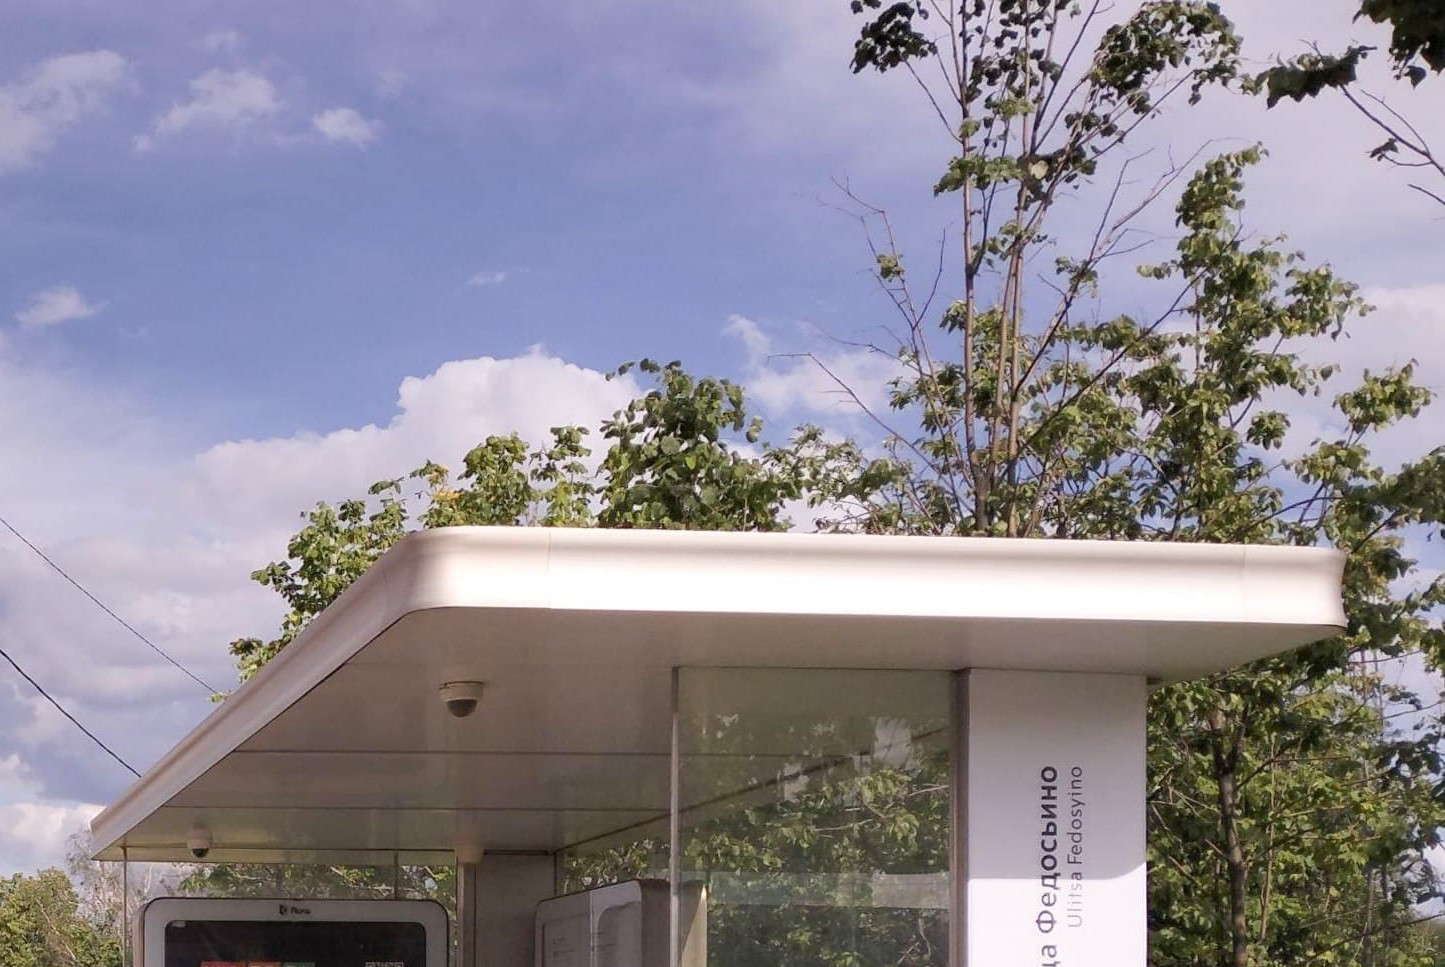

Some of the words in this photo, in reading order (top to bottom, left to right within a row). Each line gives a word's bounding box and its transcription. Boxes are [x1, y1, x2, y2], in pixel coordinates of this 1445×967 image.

[1035, 766, 1061, 934] Федосьино
[1067, 766, 1086, 865] Fedosyino
[1067, 872, 1083, 928] Ulitsa
